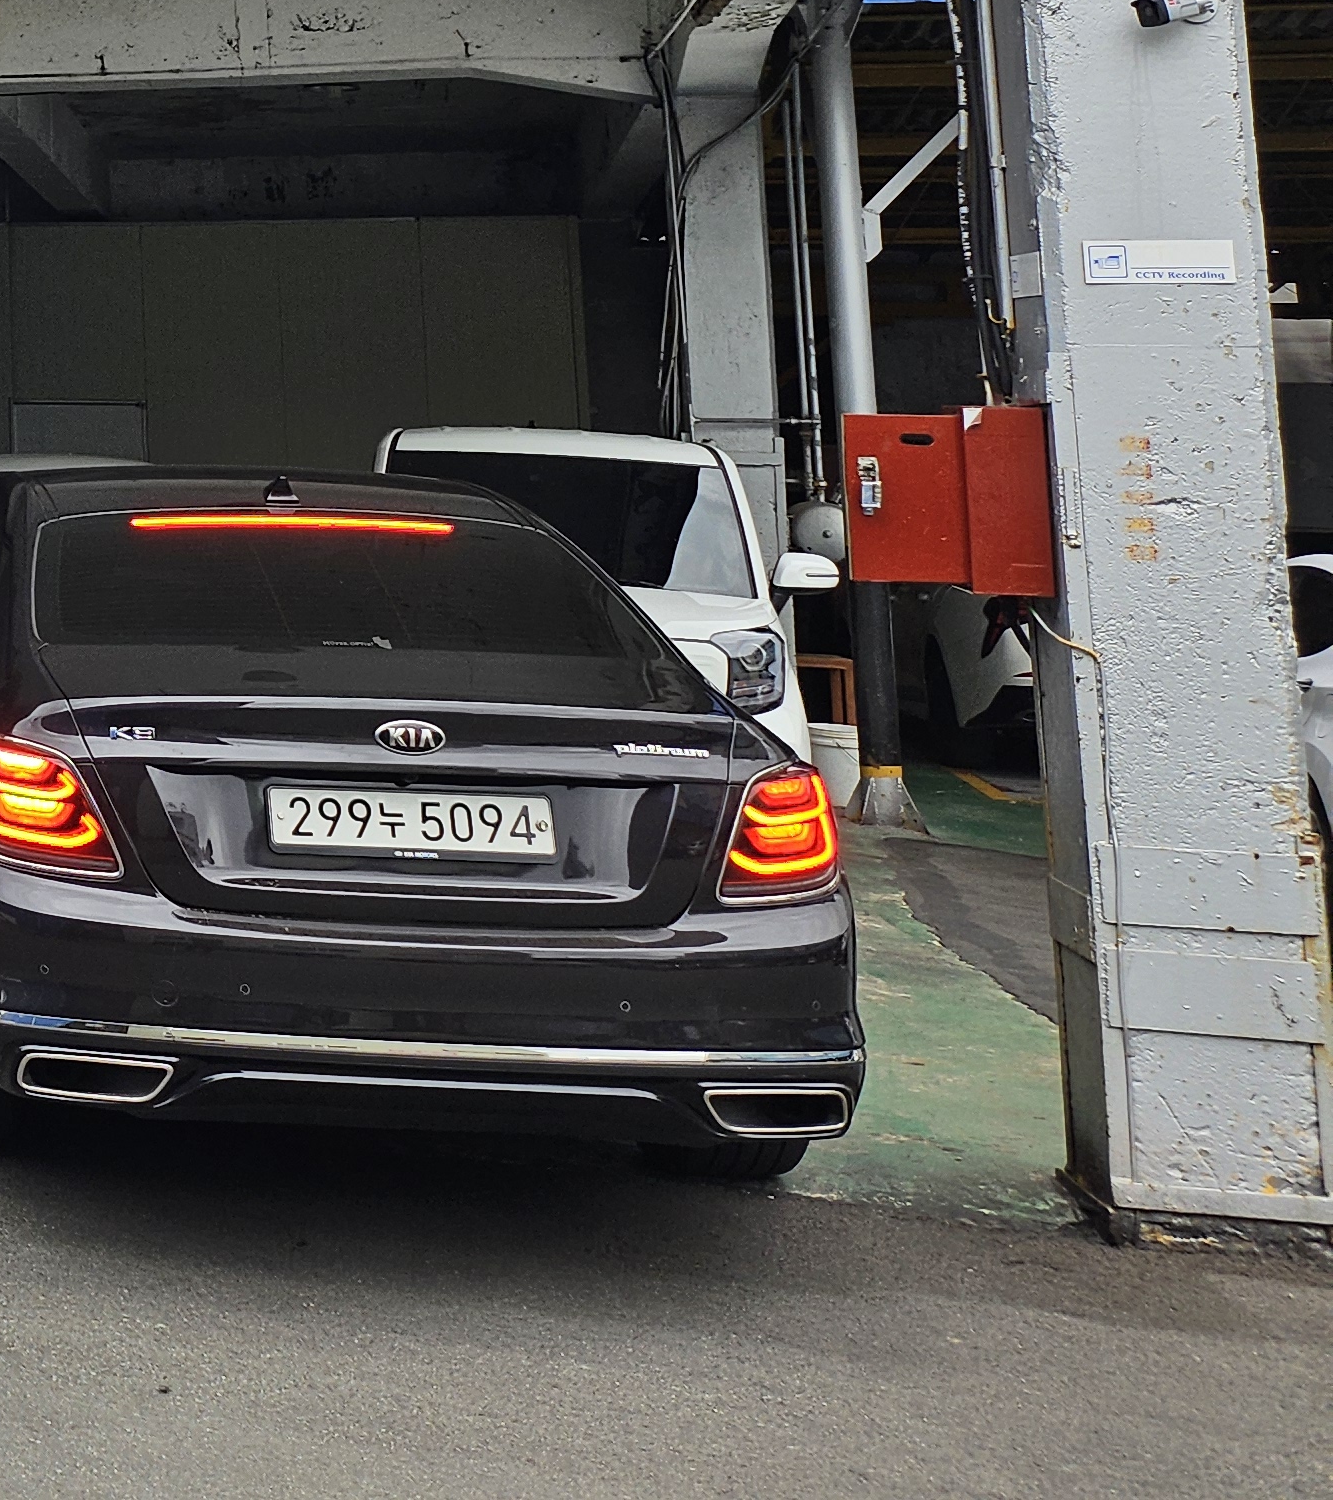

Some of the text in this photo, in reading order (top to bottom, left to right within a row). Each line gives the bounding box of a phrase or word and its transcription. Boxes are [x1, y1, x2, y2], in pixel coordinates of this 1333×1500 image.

[1135, 271, 1226, 280] CCTV Recording
[387, 727, 436, 749] KIA
[289, 796, 537, 845] 299누 5094
